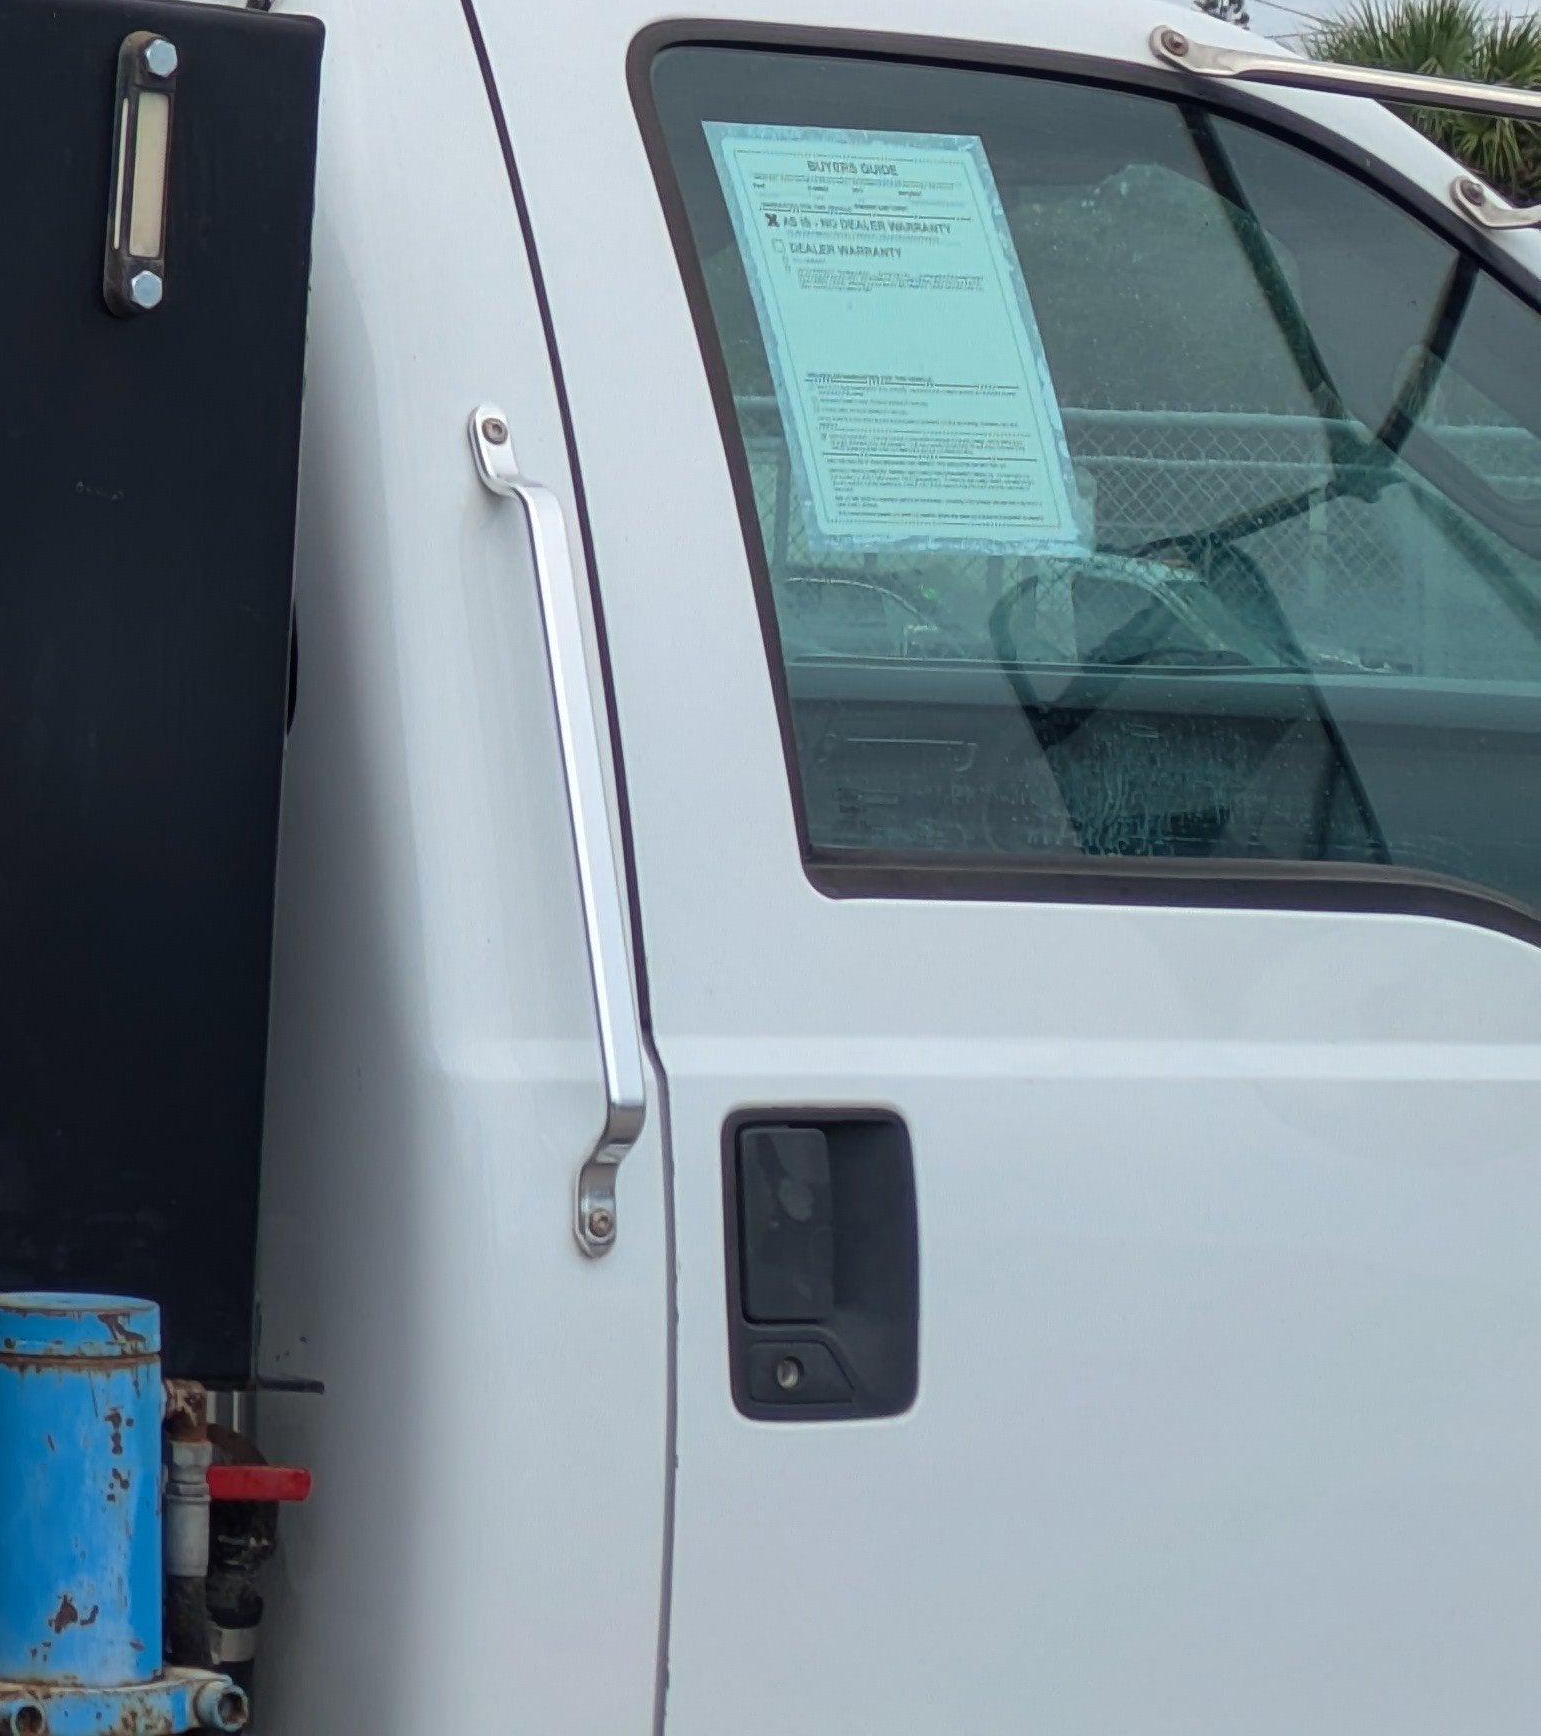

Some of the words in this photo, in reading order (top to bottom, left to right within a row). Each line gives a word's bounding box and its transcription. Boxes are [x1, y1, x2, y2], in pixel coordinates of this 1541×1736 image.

[861, 163, 899, 176] GUIDE
[840, 219, 885, 232] DEALER
[888, 221, 951, 234] WARRANTY
[790, 243, 835, 255] DEALER
[837, 245, 902, 258] WARRANTY
